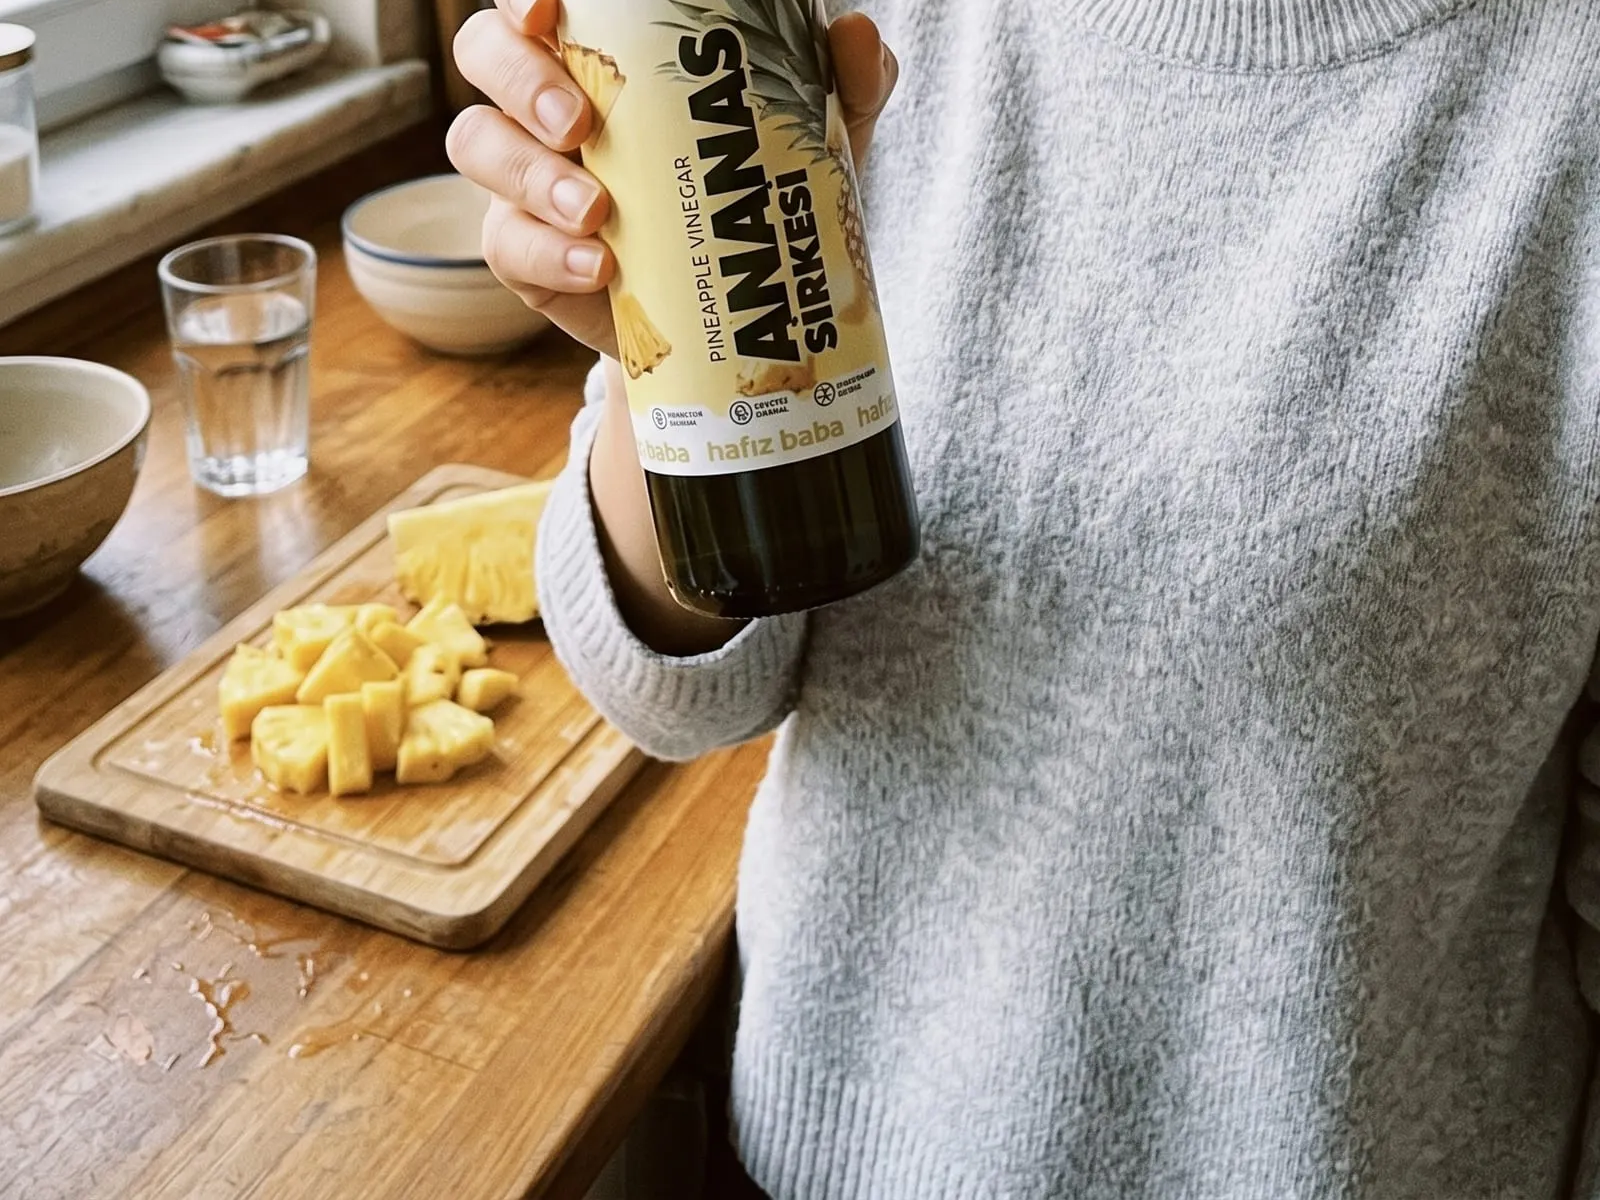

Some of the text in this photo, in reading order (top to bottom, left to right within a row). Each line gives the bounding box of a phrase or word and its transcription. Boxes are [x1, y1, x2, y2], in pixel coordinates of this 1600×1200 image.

[674, 155, 726, 362] PINEAPPLE VINEGAR
[678, 25, 801, 362] ANANAS
[645, 439, 690, 463] baba
[780, 417, 845, 451] baba
